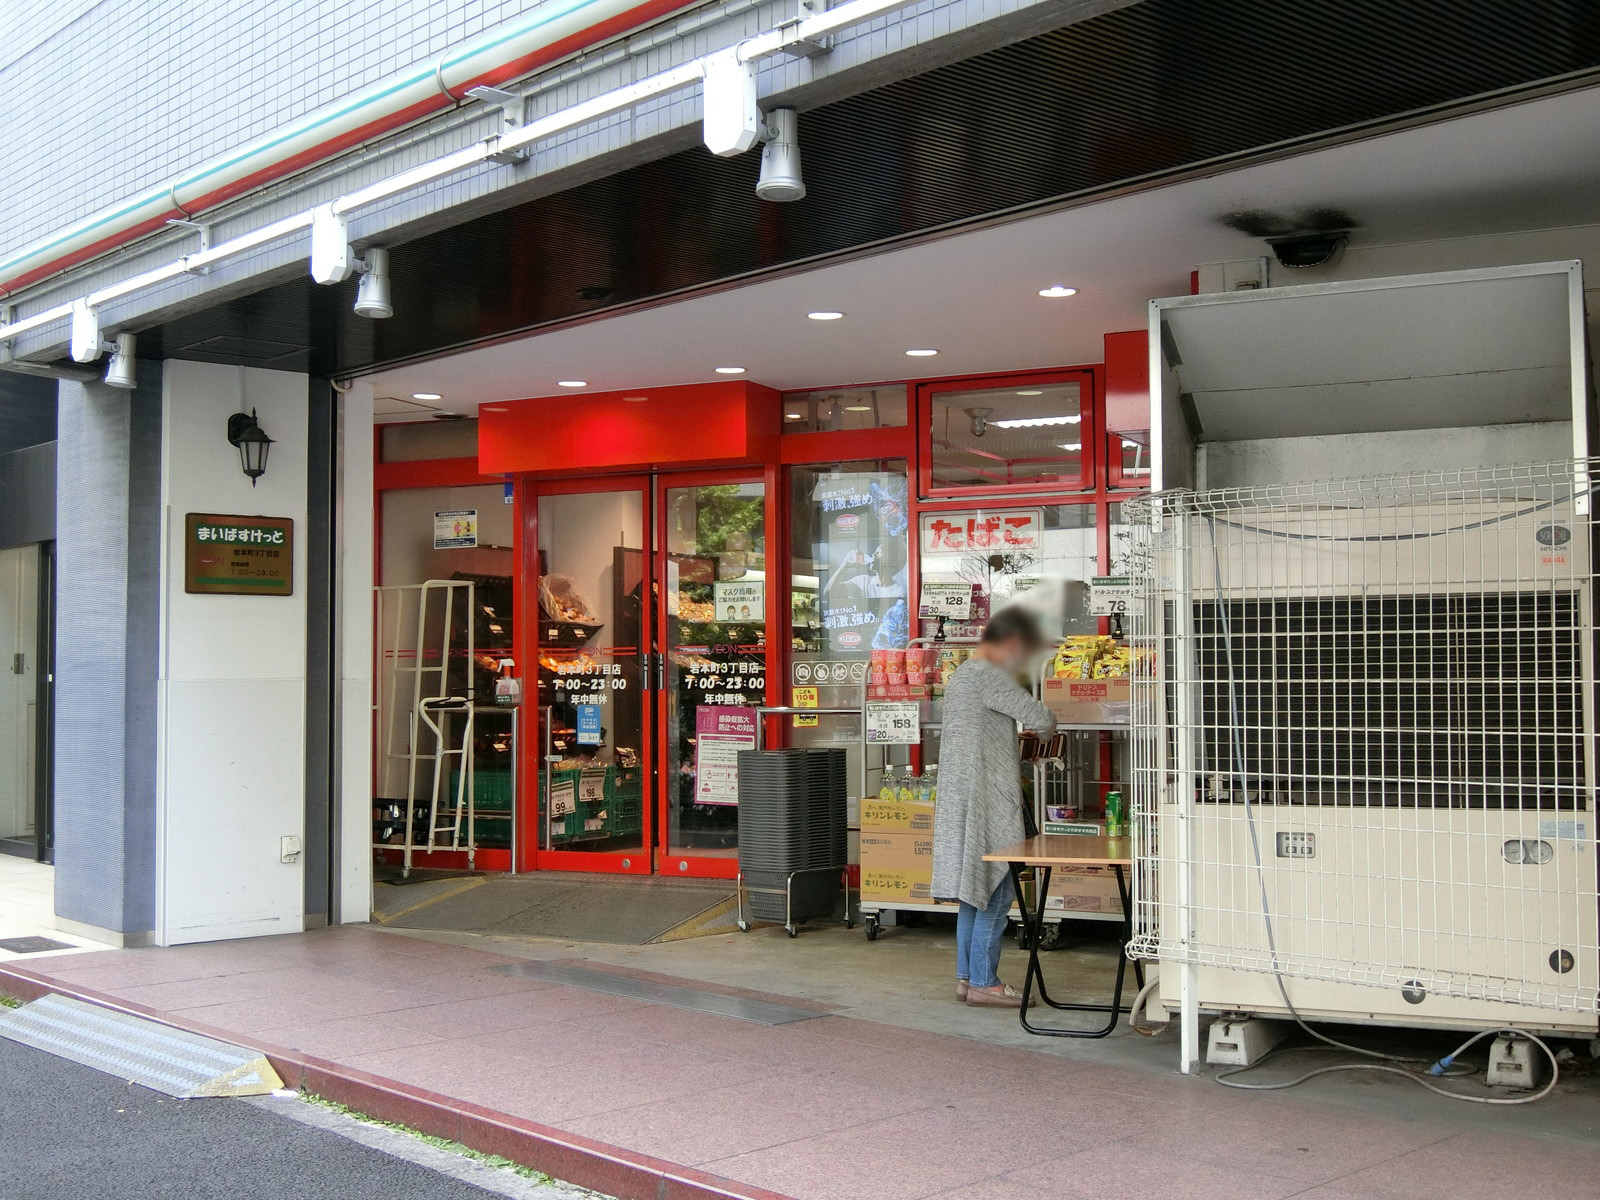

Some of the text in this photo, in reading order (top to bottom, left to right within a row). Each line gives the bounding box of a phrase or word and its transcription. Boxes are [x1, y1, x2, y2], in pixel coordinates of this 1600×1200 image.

[197, 527, 284, 544] まいばすけっと
[930, 516, 1034, 548] たばこ
[945, 597, 963, 605] 128
[1108, 600, 1127, 612] 78
[929, 606, 939, 614] 30
[557, 664, 622, 675] 岩本町3丁目店
[690, 662, 760, 674] 岩本町3丁目店
[570, 694, 608, 705] 年中無休
[704, 693, 743, 705] 年中無休
[718, 715, 750, 724] 感染症拡大
[893, 719, 911, 729] 158
[718, 723, 755, 733] 防止への対応
[877, 730, 887, 739] 20
[555, 802, 566, 812] 99
[864, 811, 909, 820] キリンレモン
[864, 879, 909, 889] キリンレモン
